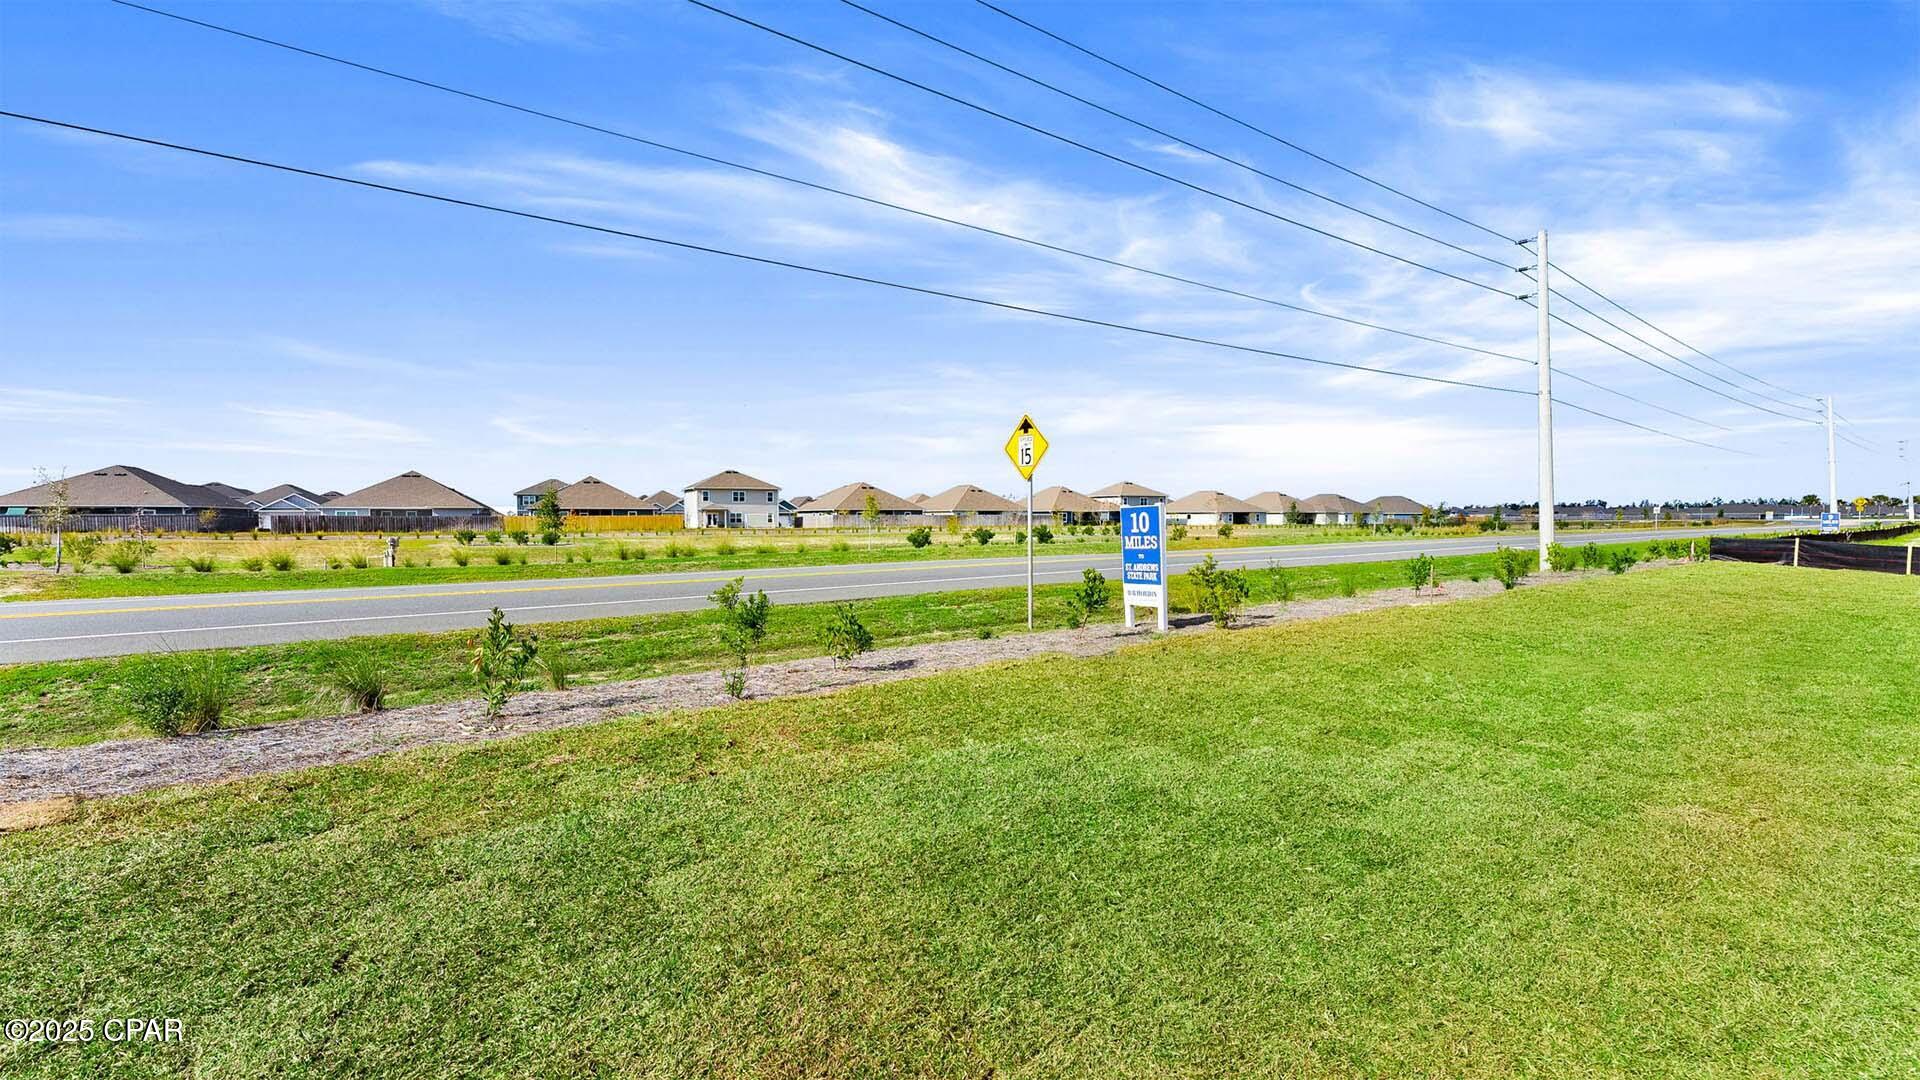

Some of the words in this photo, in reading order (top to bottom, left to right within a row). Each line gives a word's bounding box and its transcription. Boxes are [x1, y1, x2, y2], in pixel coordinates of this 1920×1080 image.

[1021, 448, 1031, 465] 15
[1130, 511, 1150, 533] 10
[1125, 535, 1158, 550] MILES
